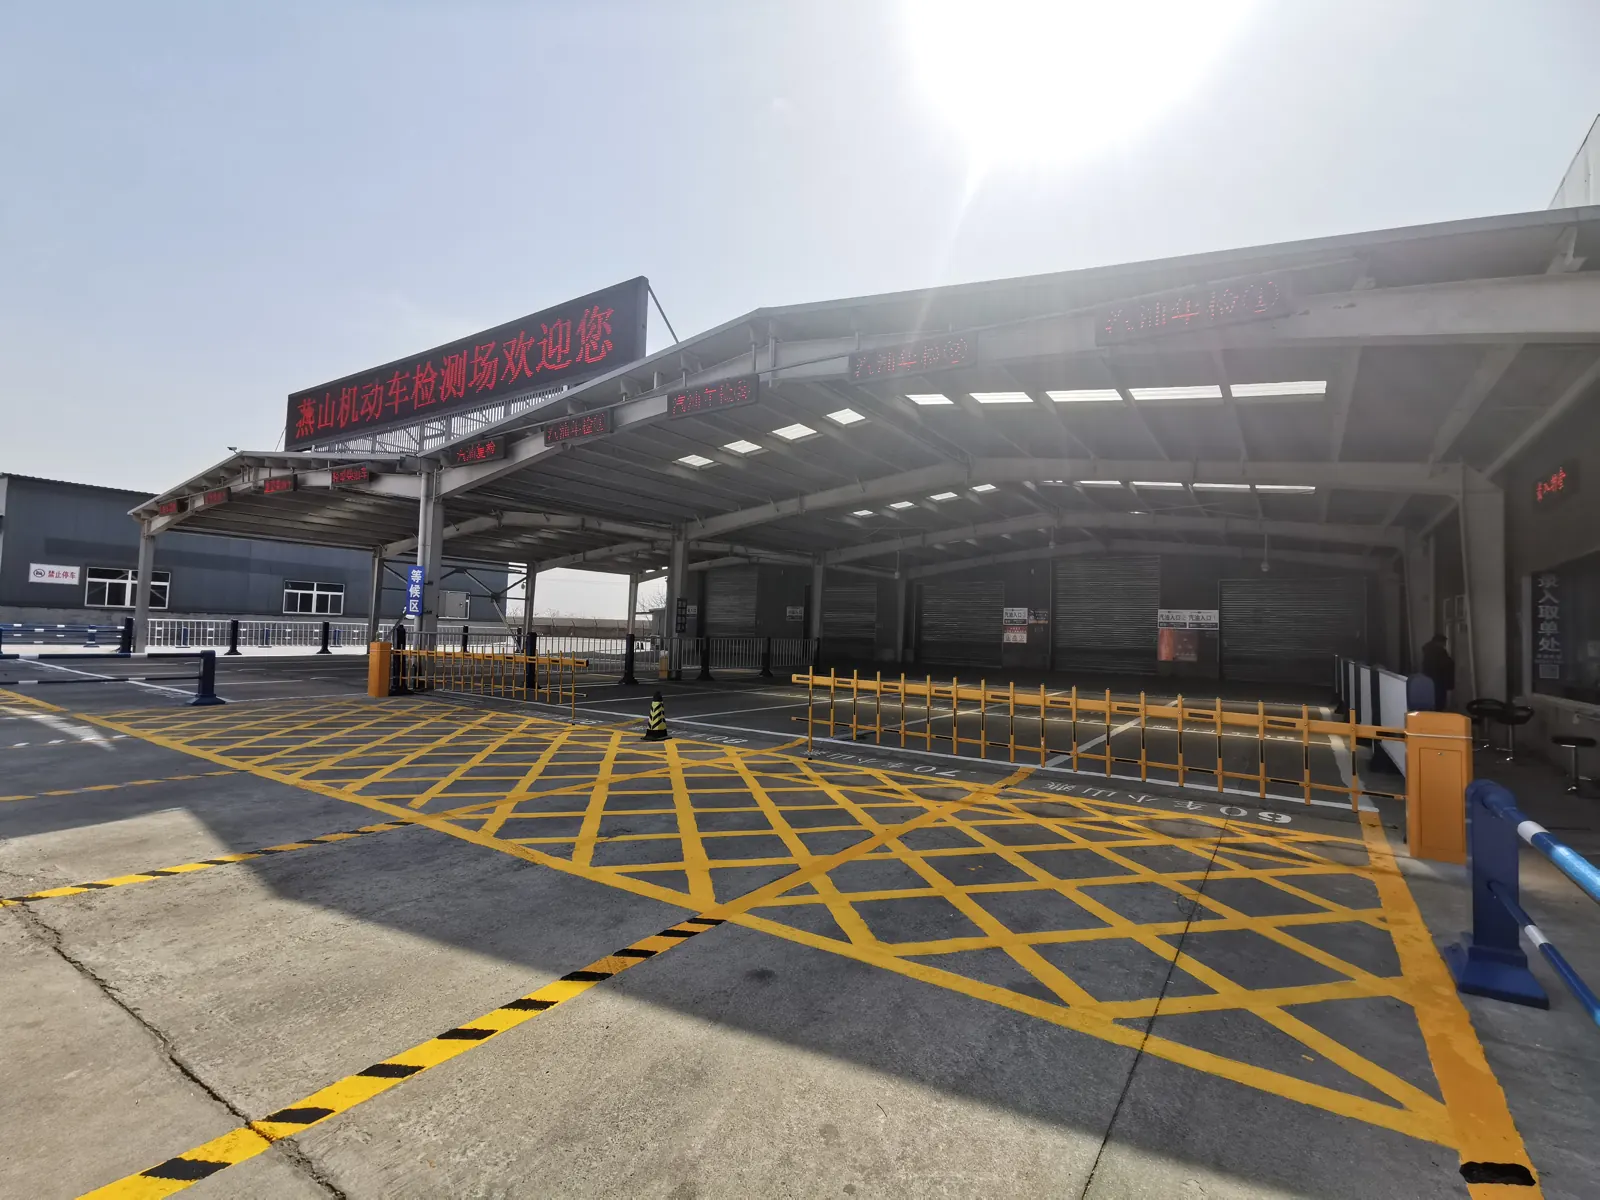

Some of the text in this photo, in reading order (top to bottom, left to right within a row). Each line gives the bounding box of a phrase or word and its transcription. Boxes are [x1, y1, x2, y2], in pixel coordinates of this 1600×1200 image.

[295, 305, 614, 439] 燕山机动车检测场欢迎您
[47, 570, 77, 580] 禁止停车
[409, 569, 422, 613] 等候区
